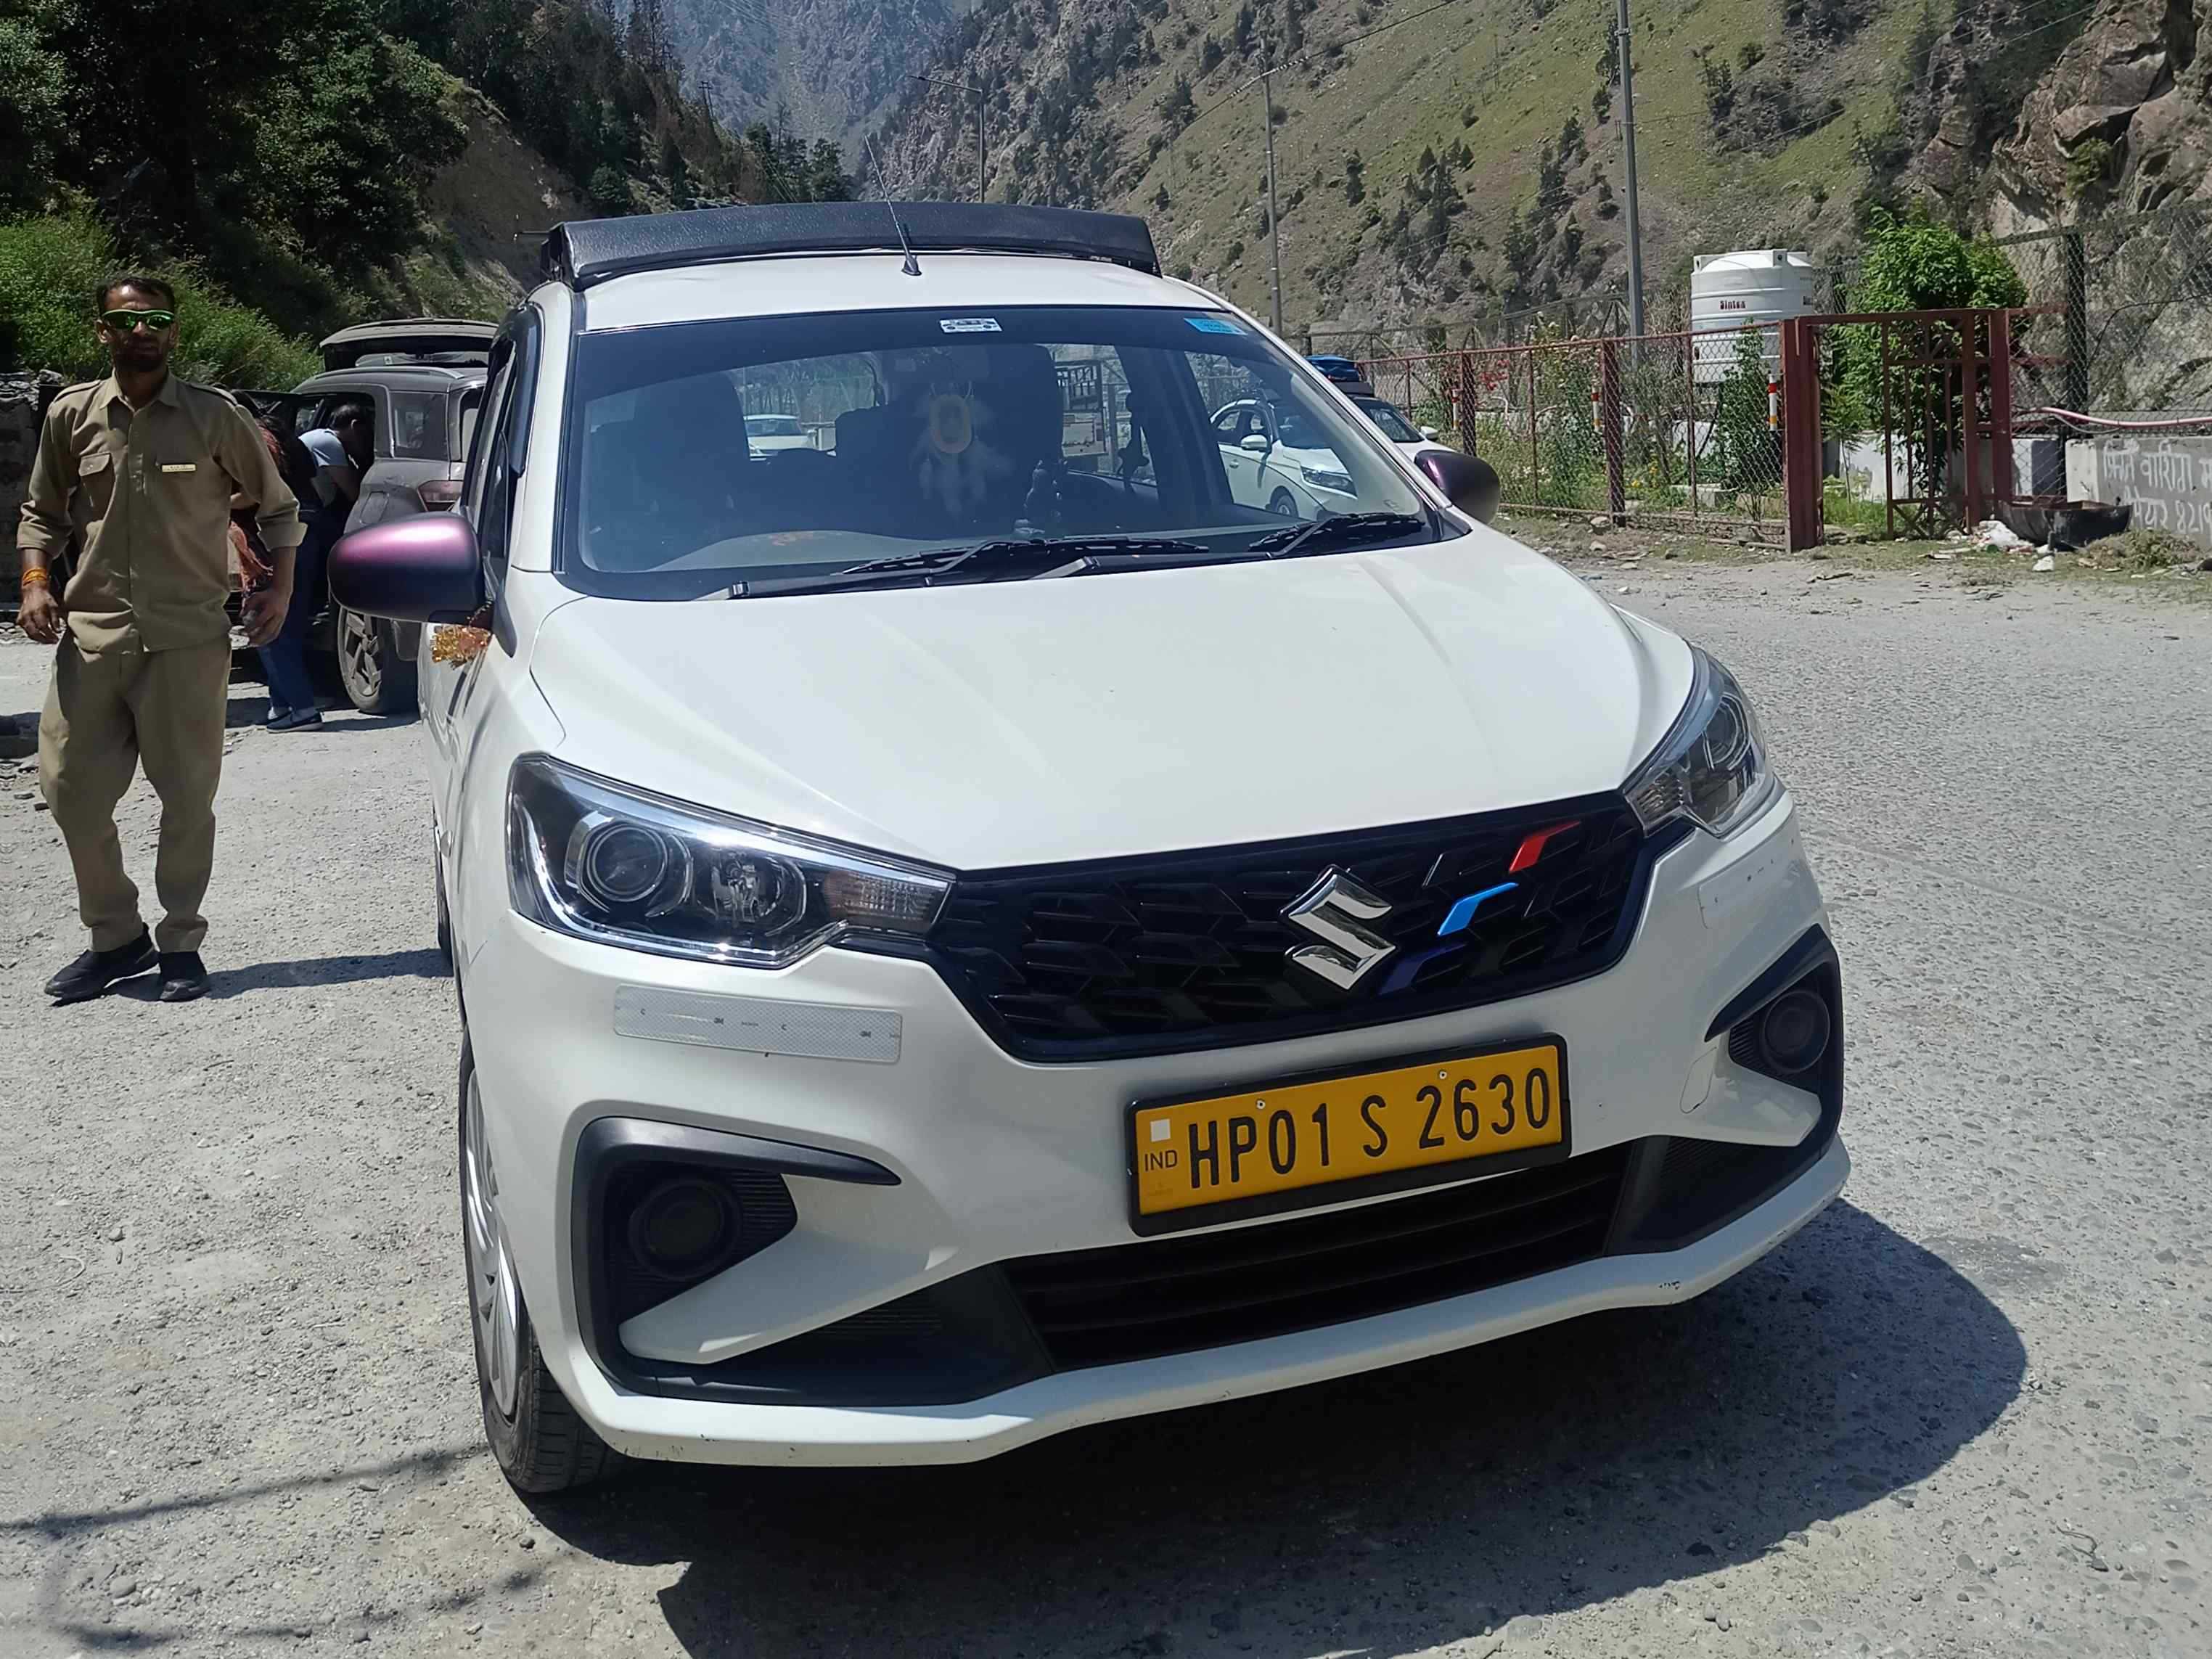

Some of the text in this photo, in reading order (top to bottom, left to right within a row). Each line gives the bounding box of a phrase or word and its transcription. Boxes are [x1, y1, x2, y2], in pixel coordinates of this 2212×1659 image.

[1144, 1150, 1178, 1172] IND
[1188, 1068, 1550, 1189] HP01 S 2630
